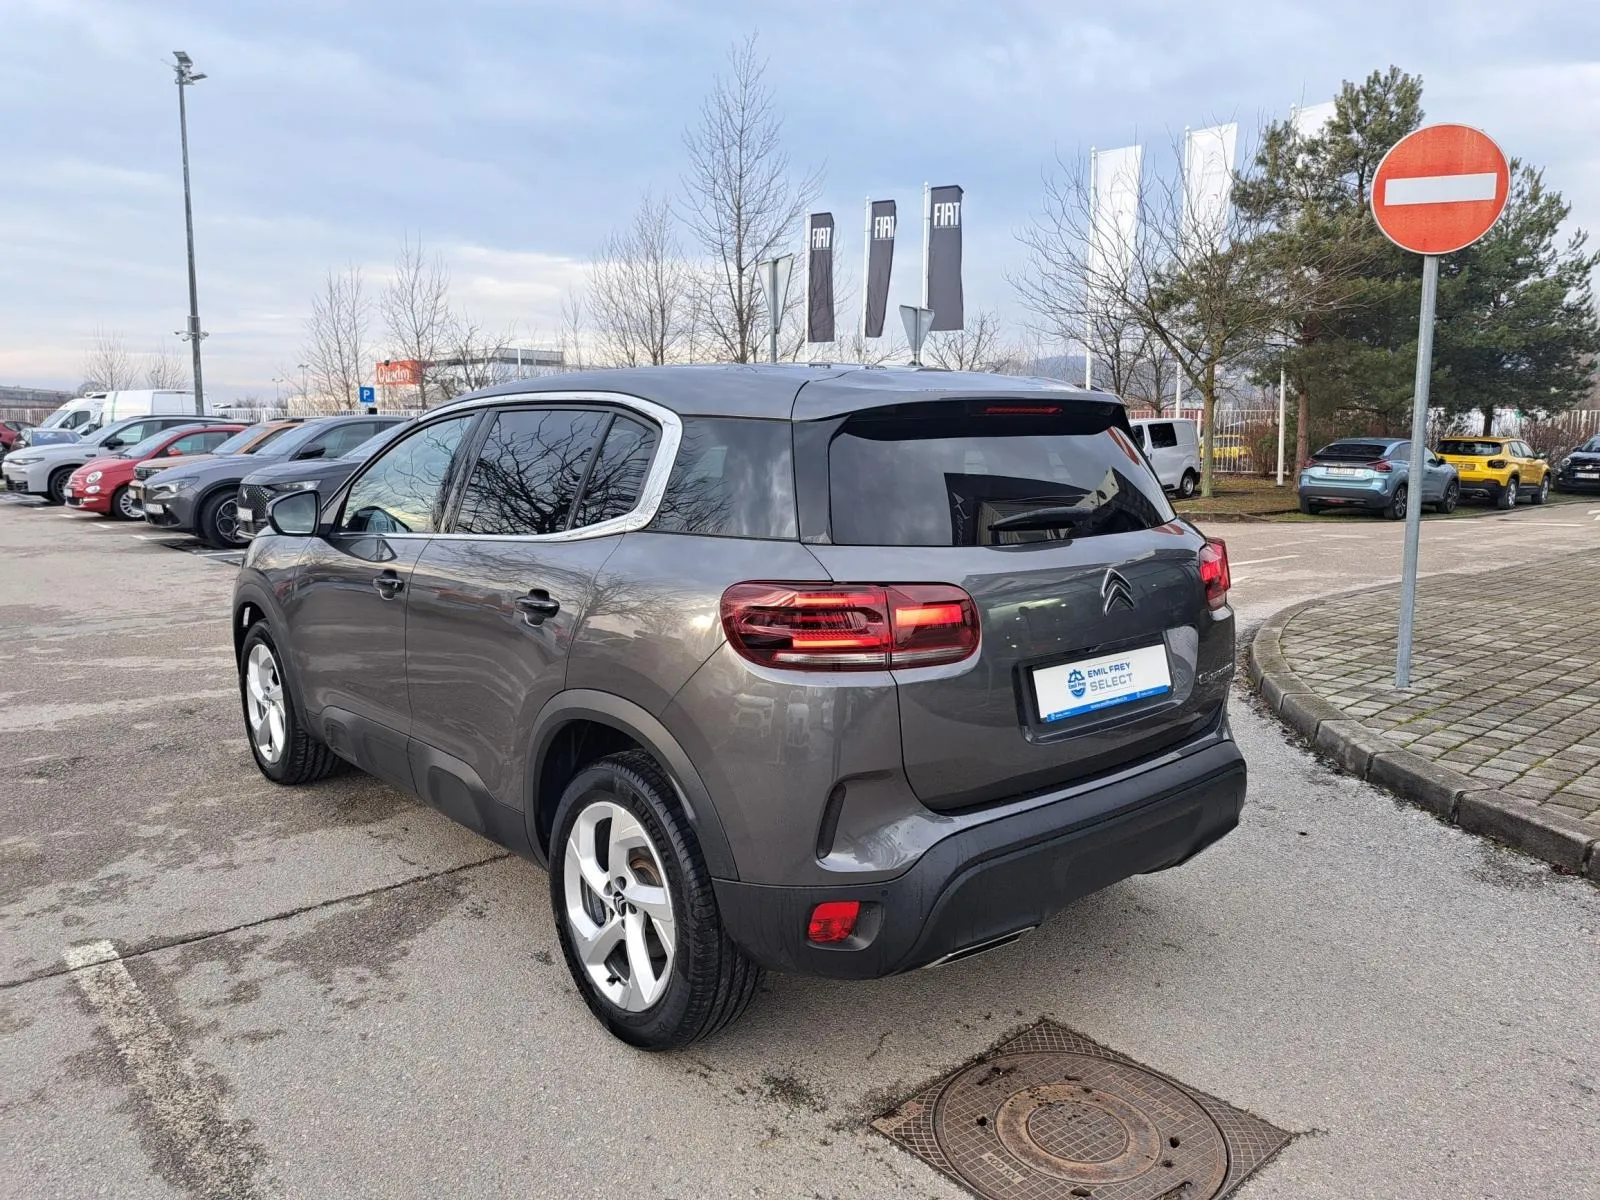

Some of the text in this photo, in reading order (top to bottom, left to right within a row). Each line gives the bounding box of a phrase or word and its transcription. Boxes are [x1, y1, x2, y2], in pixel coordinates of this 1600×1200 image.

[934, 202, 960, 226] FIAT
[874, 215, 895, 239] FIAT
[812, 227, 831, 249] FIAT
[363, 389, 371, 401] P
[1087, 662, 1130, 678] EMIL FREY
[1090, 672, 1133, 692] SELECT
